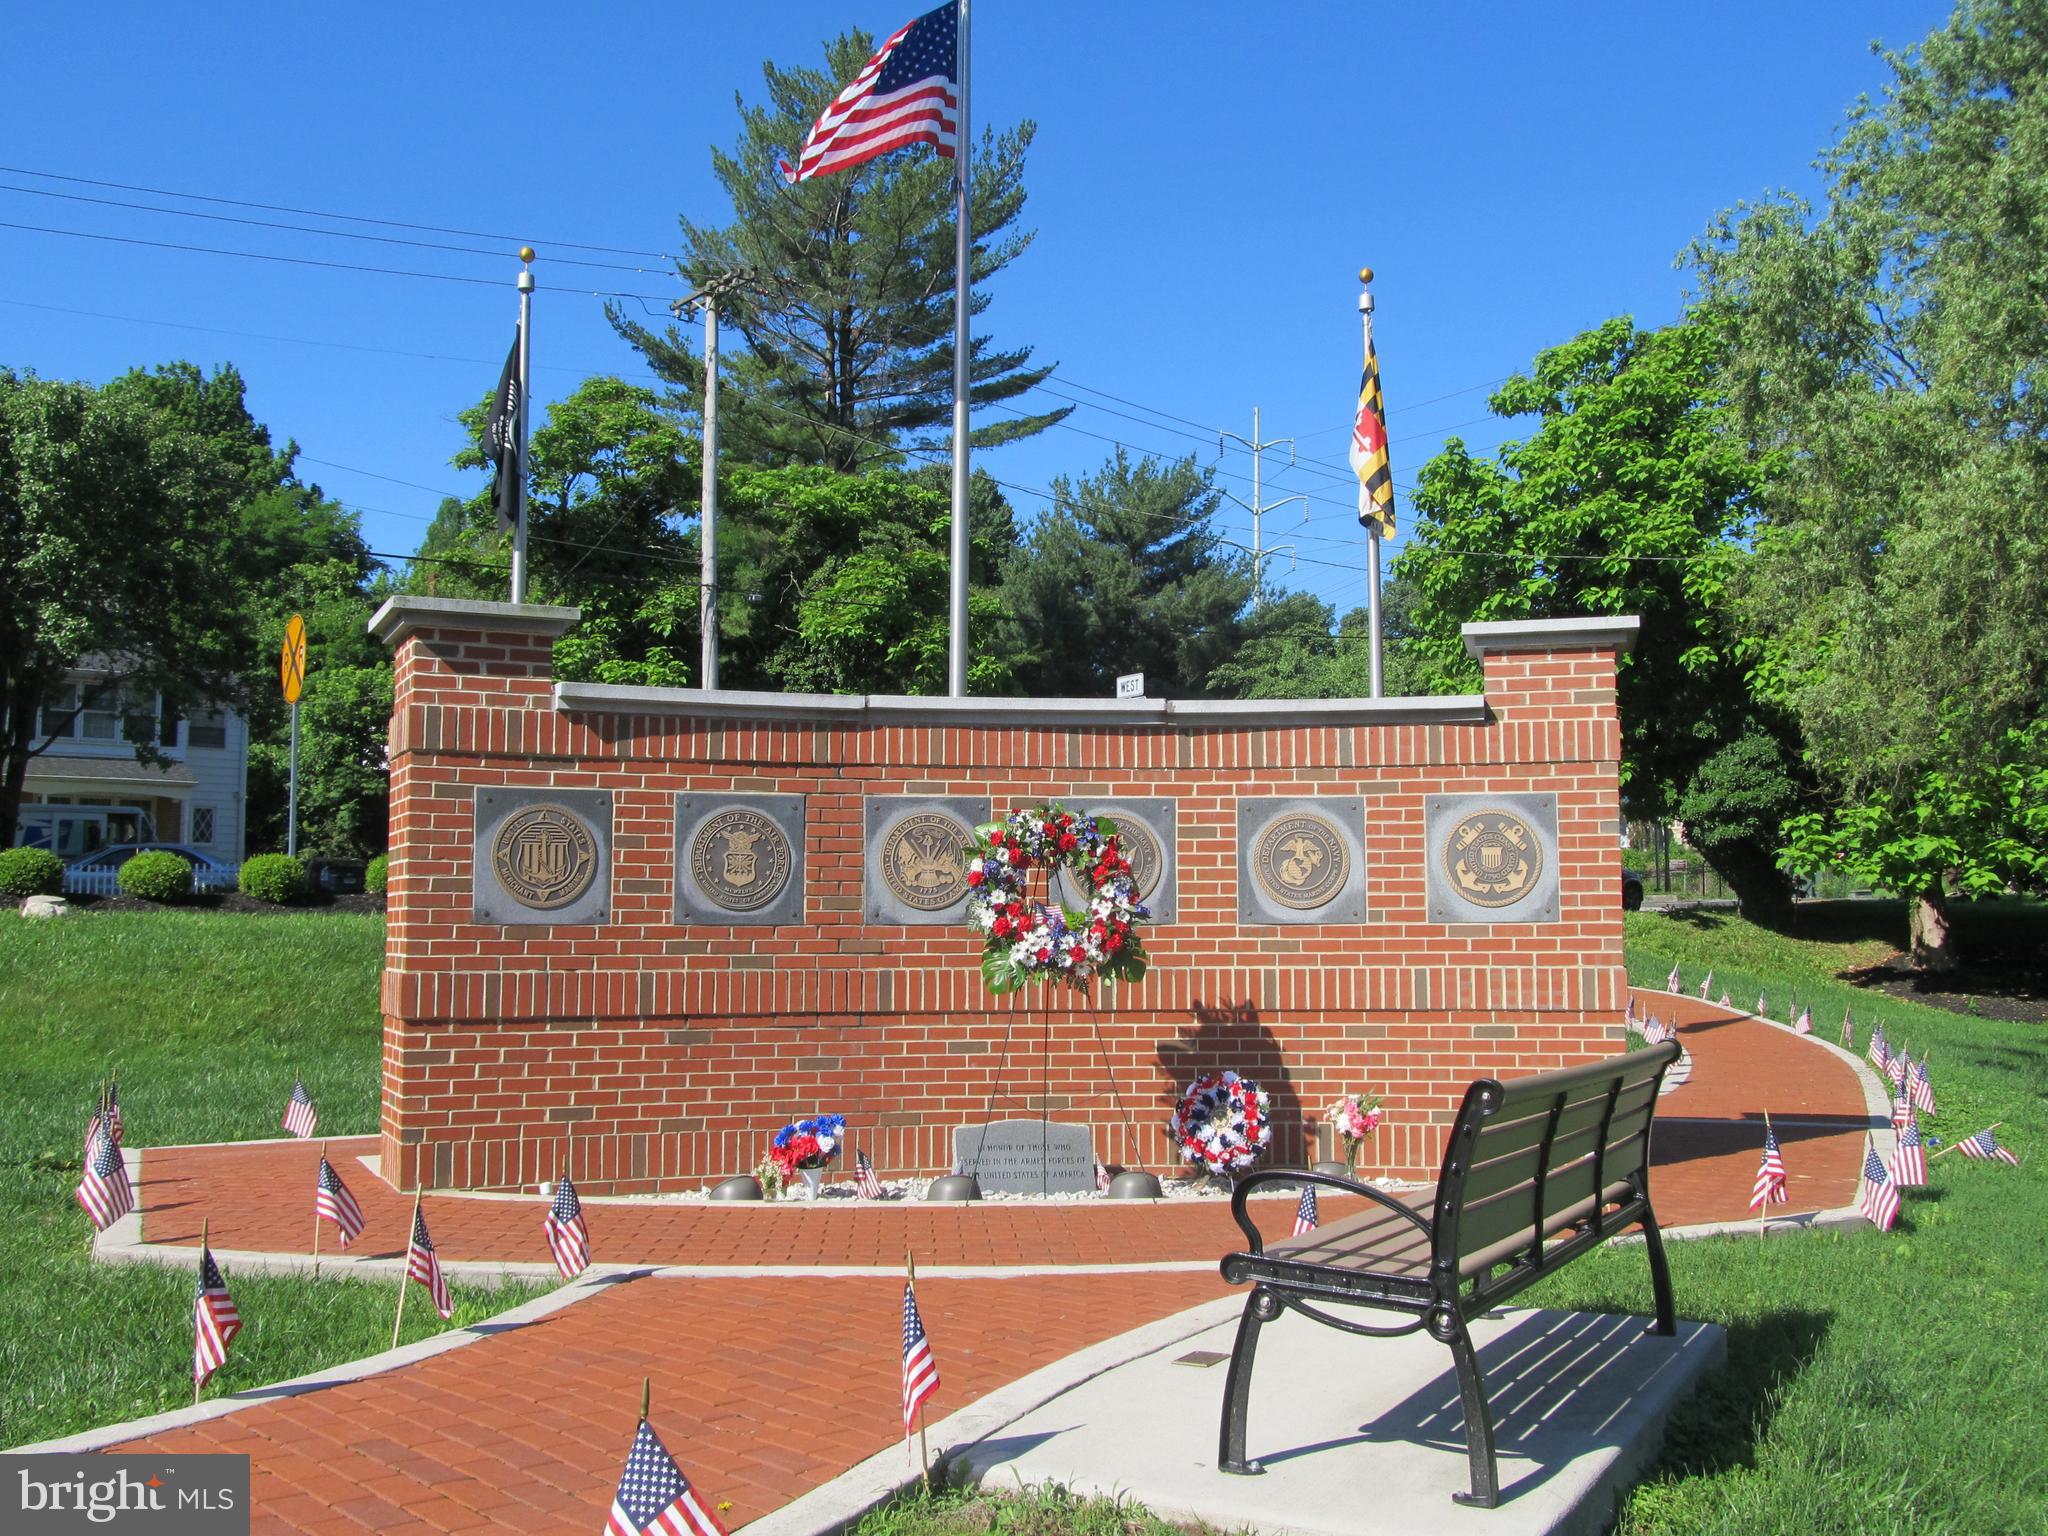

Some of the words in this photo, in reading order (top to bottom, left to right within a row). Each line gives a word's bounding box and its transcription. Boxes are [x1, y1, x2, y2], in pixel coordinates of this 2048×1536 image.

[1120, 679, 1140, 692] WEST
[502, 818, 526, 845] UNITED
[560, 816, 586, 846] STATES
[884, 816, 926, 856] DEPARTMENT
[944, 822, 958, 834] THE
[1126, 824, 1139, 837] THE
[1138, 836, 1152, 854] NAVY
[1262, 820, 1306, 864] DEPARTMENT
[1318, 828, 1330, 840] THE
[1328, 838, 1341, 863] NAVY
[694, 820, 724, 874] DEPARTMENT
[726, 814, 741, 822] OF
[746, 814, 766, 828] THE
[765, 826, 781, 844] AIR
[773, 846, 786, 880] FORCE
[500, 867, 534, 898] MERCHANT
[559, 872, 584, 897] MARINE
[884, 863, 902, 893] UNITED
[902, 892, 936, 906] STATES
[920, 886, 938, 894] 1775
[1139, 863, 1153, 888] ERICA
[964, 1158, 990, 1166] SERVED
[993, 1158, 1000, 1166] IN
[1004, 1157, 1016, 1166] THE
[1020, 1156, 1046, 1166] ARMED
[1048, 1156, 1074, 1165] FORCES
[1076, 1156, 1086, 1164] OF
[1016, 1144, 1024, 1152] OF
[984, 1171, 1012, 1180] UNITED
[1014, 1170, 1039, 1180] STATES
[1052, 1170, 1086, 1178] AMERICA
